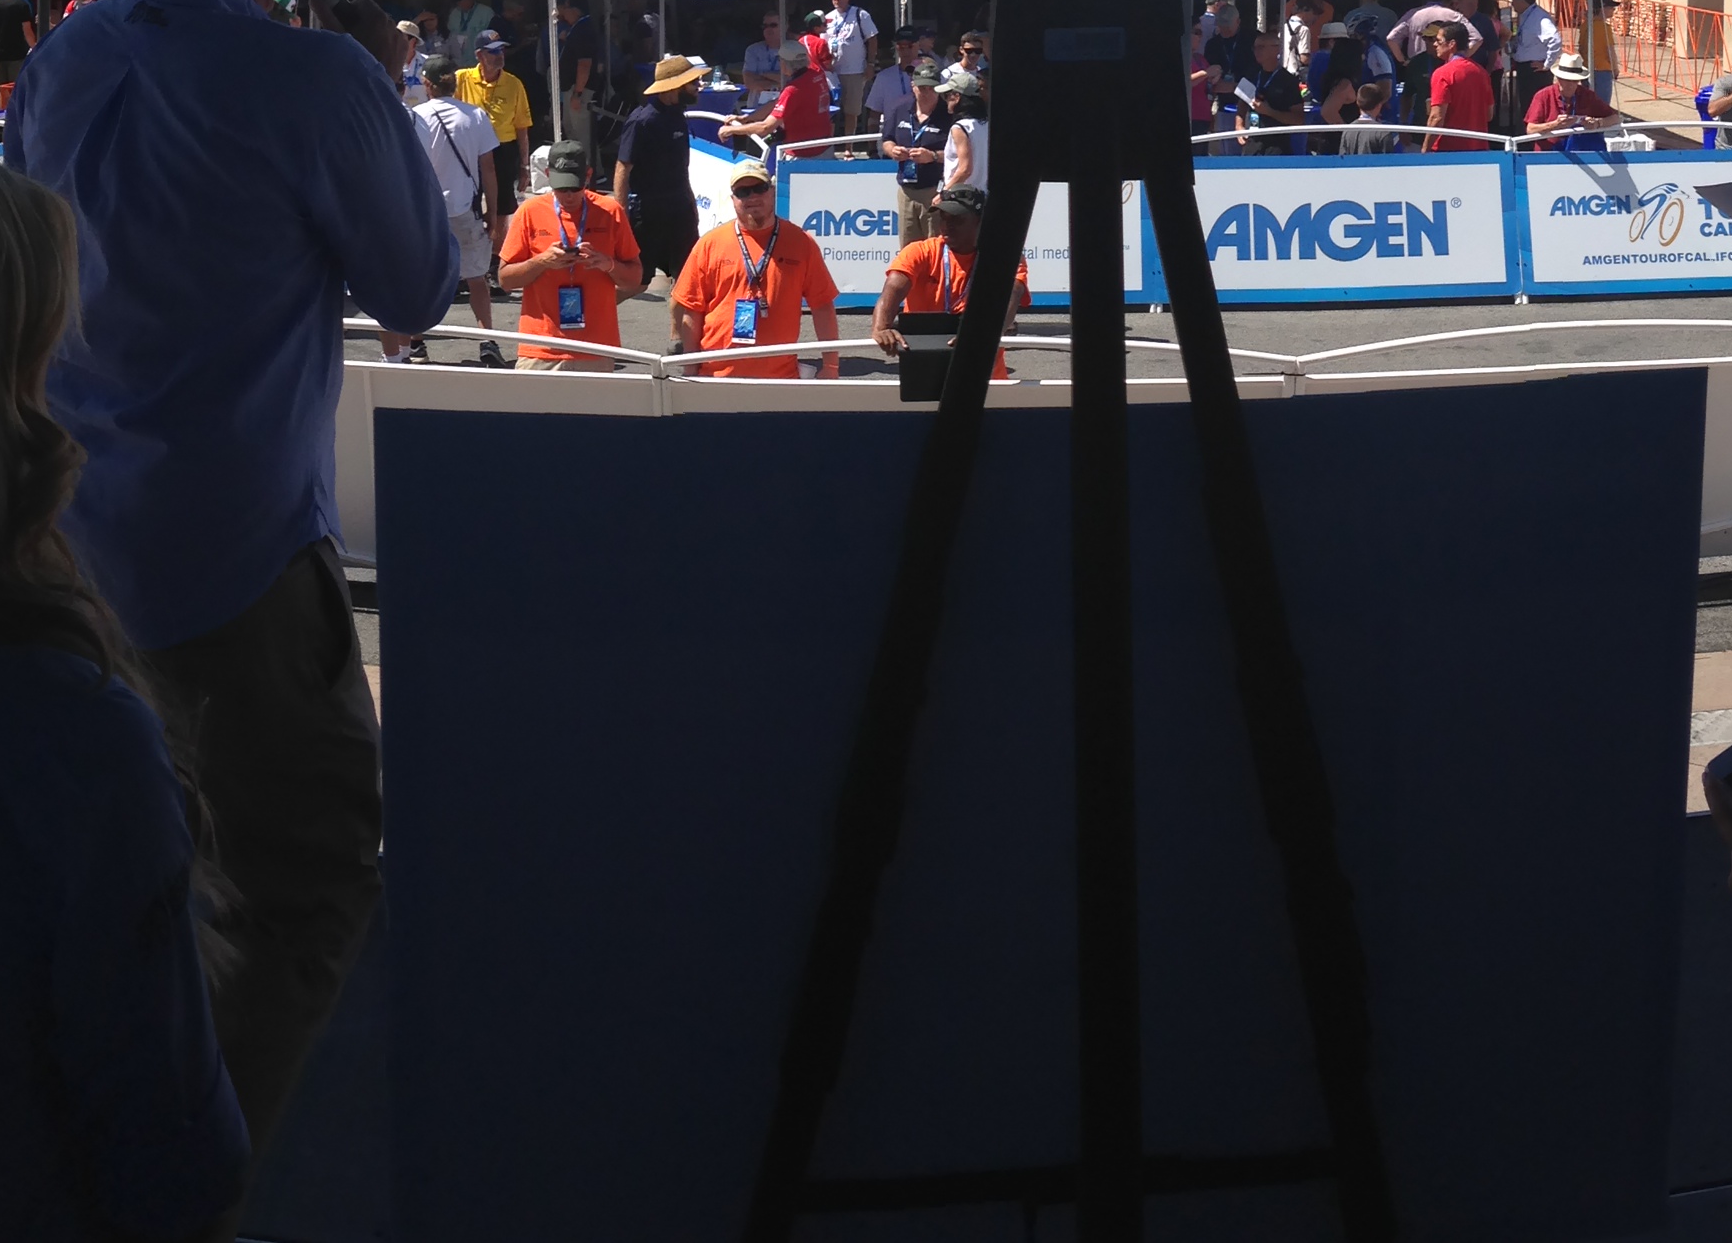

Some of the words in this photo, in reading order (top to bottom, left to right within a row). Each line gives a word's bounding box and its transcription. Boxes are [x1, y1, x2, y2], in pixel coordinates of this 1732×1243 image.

[1550, 195, 1632, 217] AMGEN
[1208, 200, 1449, 262] AMGEN
[824, 247, 890, 264] Pioneering
